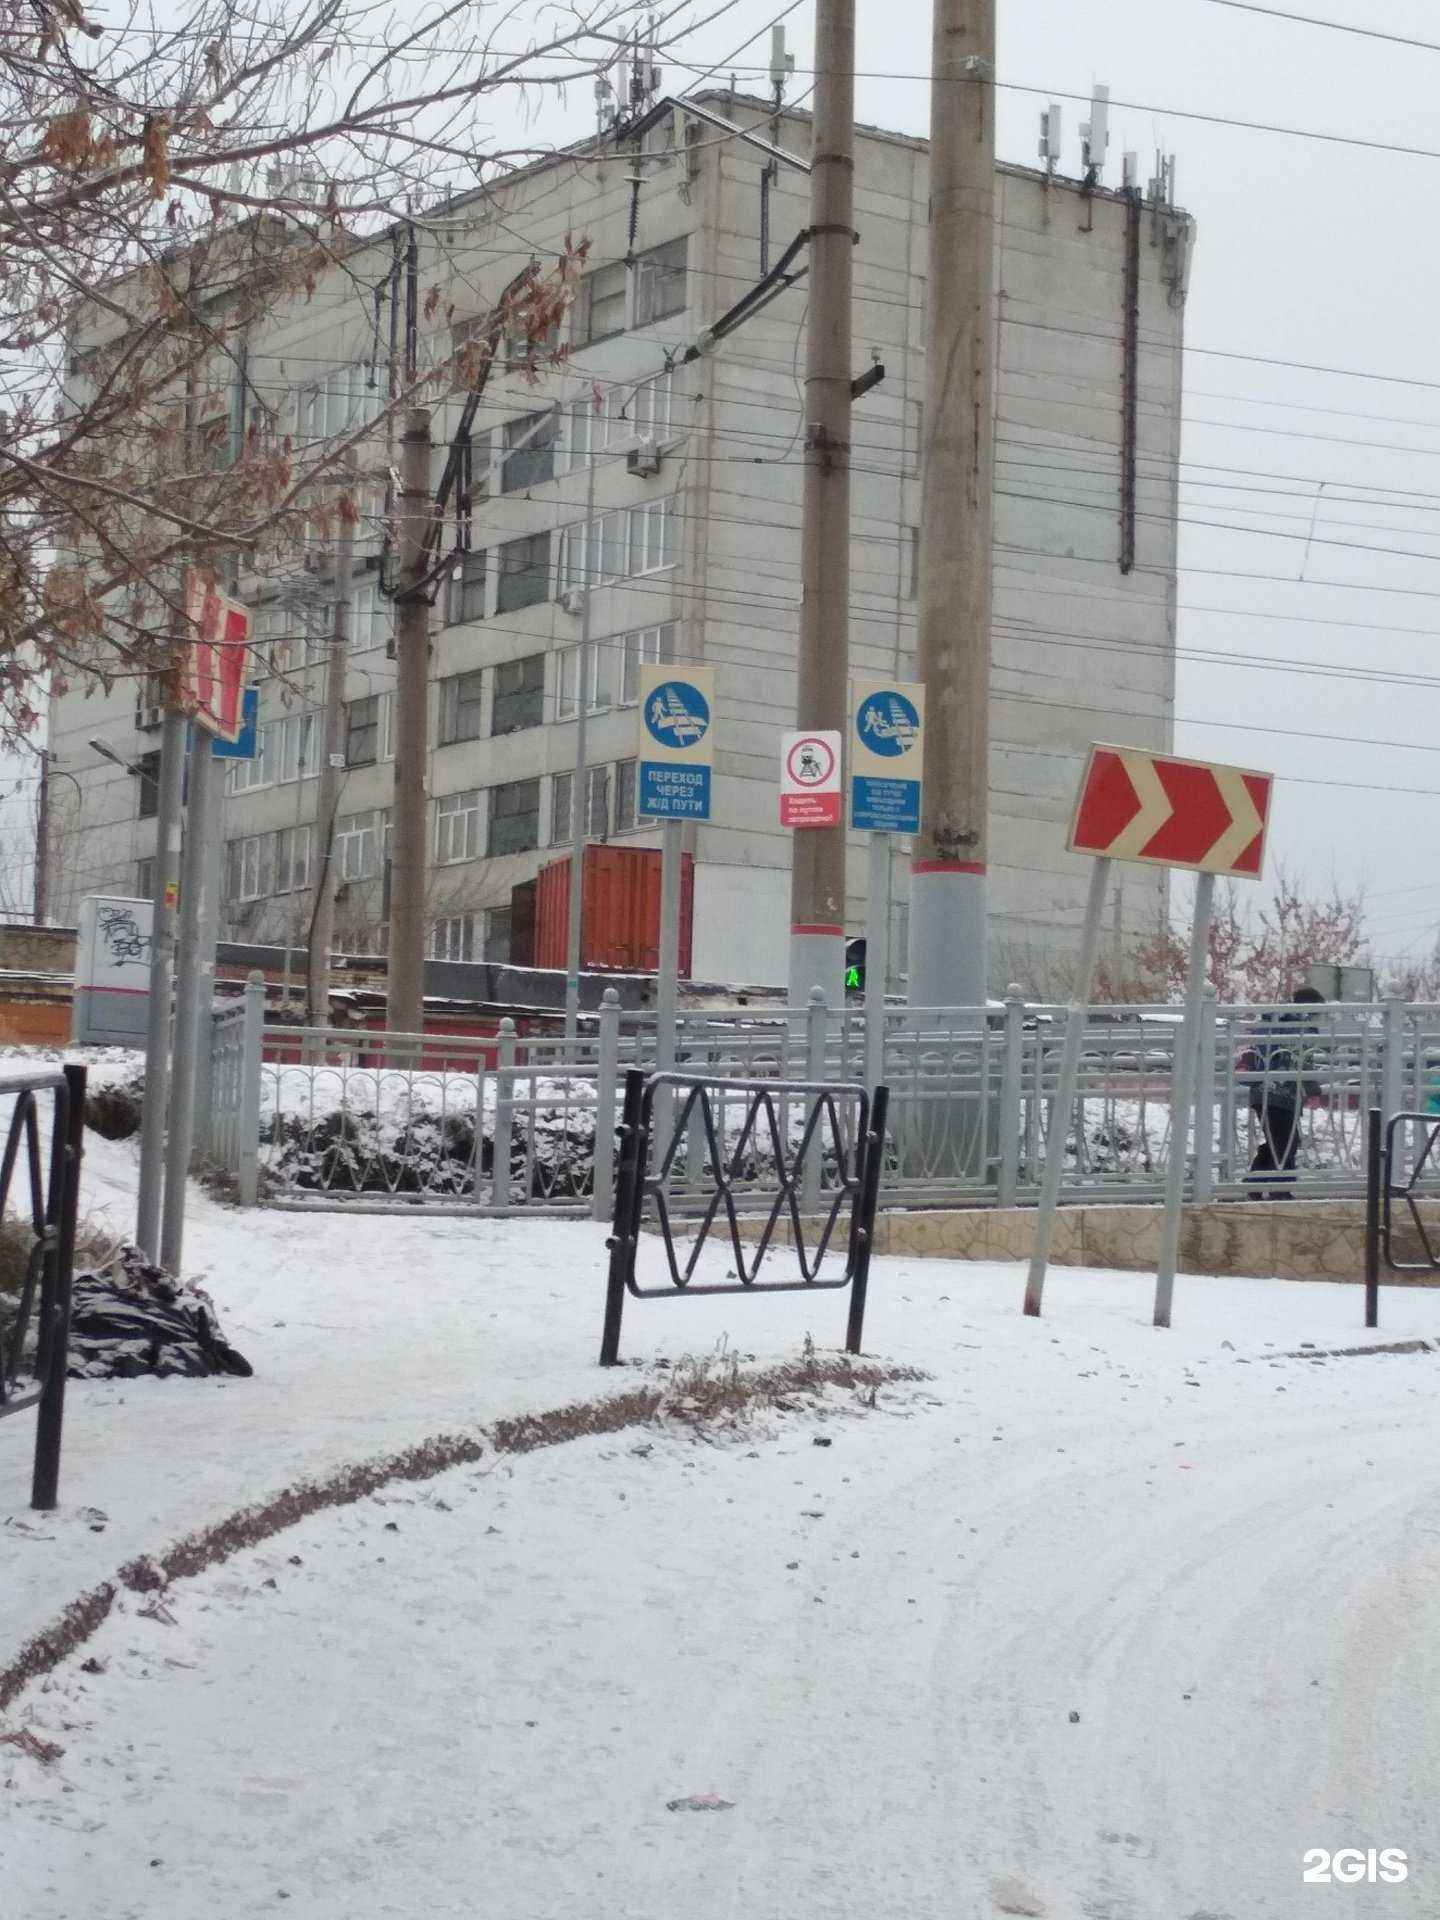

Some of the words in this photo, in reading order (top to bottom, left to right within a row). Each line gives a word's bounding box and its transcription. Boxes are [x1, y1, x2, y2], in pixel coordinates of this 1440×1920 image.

[648, 770, 703, 786] ПЕРЕХОД
[656, 784, 694, 797] ЧЕРЕЗ
[647, 797, 669, 811] Ж/Д
[672, 798, 703, 812] ПУТИ
